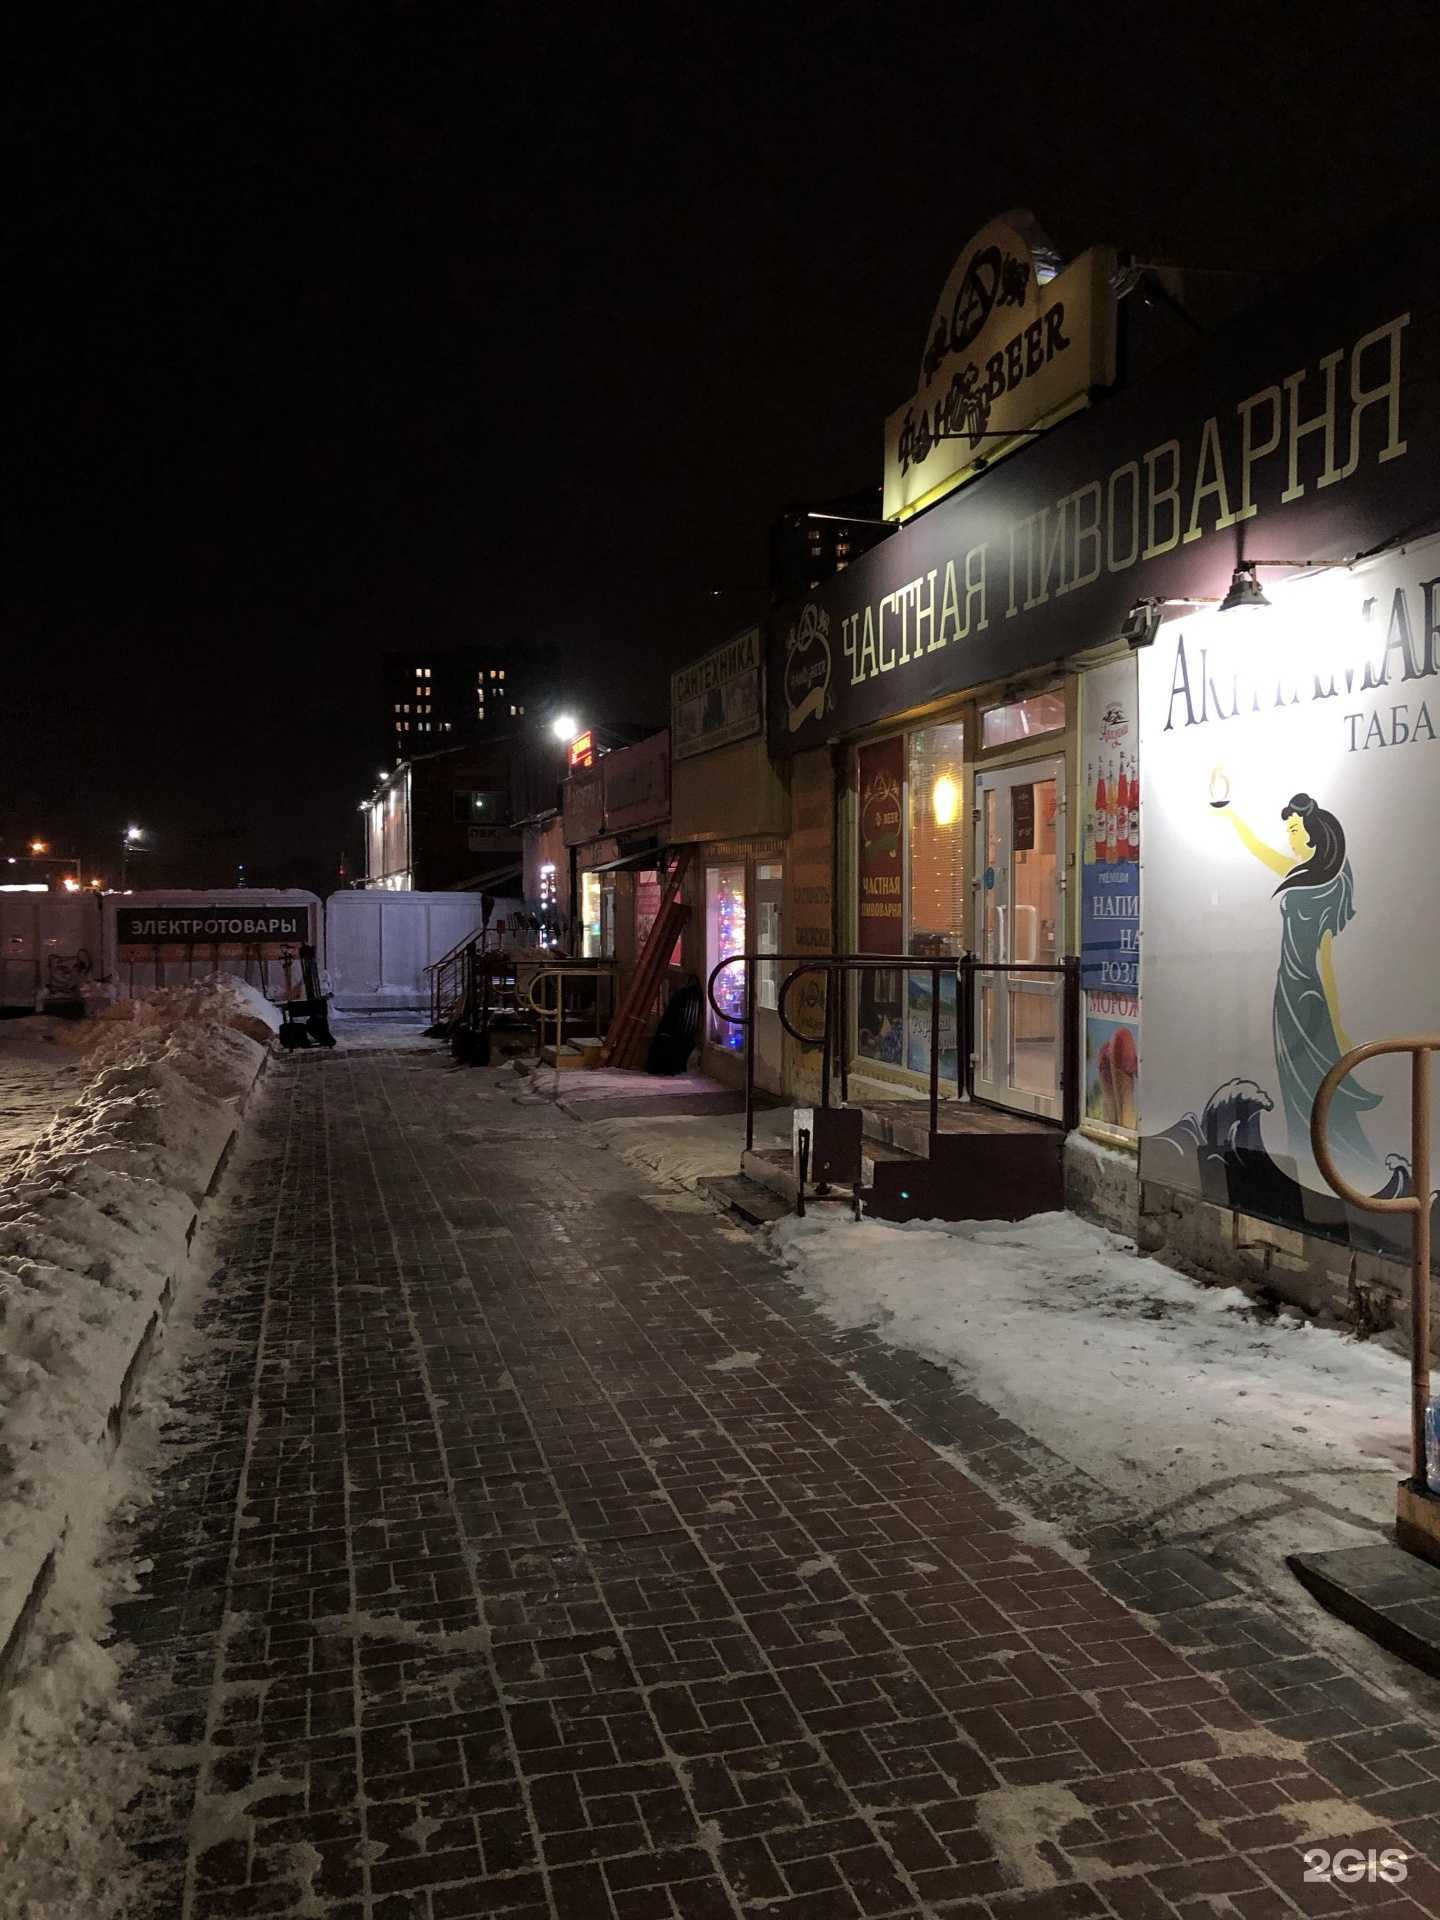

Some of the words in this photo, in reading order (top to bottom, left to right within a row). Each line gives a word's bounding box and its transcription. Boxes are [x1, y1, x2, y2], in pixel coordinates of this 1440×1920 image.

[985, 302, 1071, 401] BEER
[842, 542, 989, 685] ЧАСТНАЯ
[1005, 312, 1411, 619] ПИВОВАРНЯ
[863, 876, 901, 896] ЧАСТНАЯ
[131, 918, 297, 936] ЭЛЕКТРОТОВАРЫ
